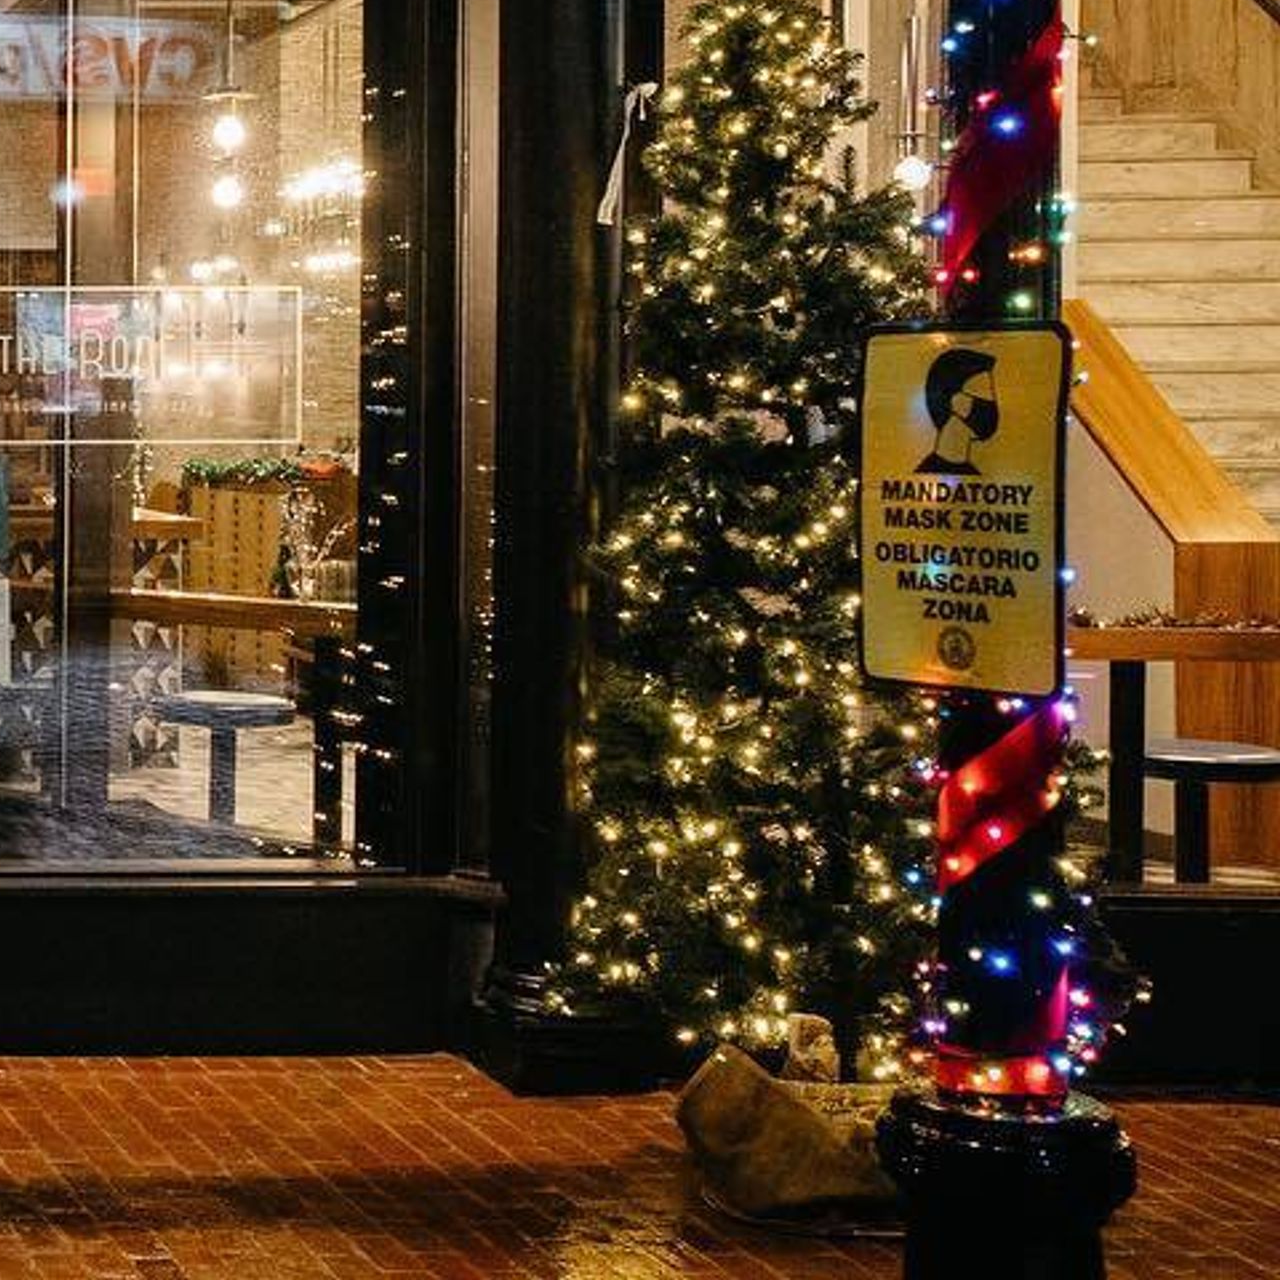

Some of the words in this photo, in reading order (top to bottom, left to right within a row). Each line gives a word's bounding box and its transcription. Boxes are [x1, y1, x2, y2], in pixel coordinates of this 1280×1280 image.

[880, 480, 1034, 505] MANDATORY
[884, 507, 952, 530] MASK
[959, 510, 1030, 535] ZONE
[875, 541, 1040, 572] OBLIGATORIO
[896, 570, 1017, 599] MASCARA
[922, 598, 992, 623] ZONA
